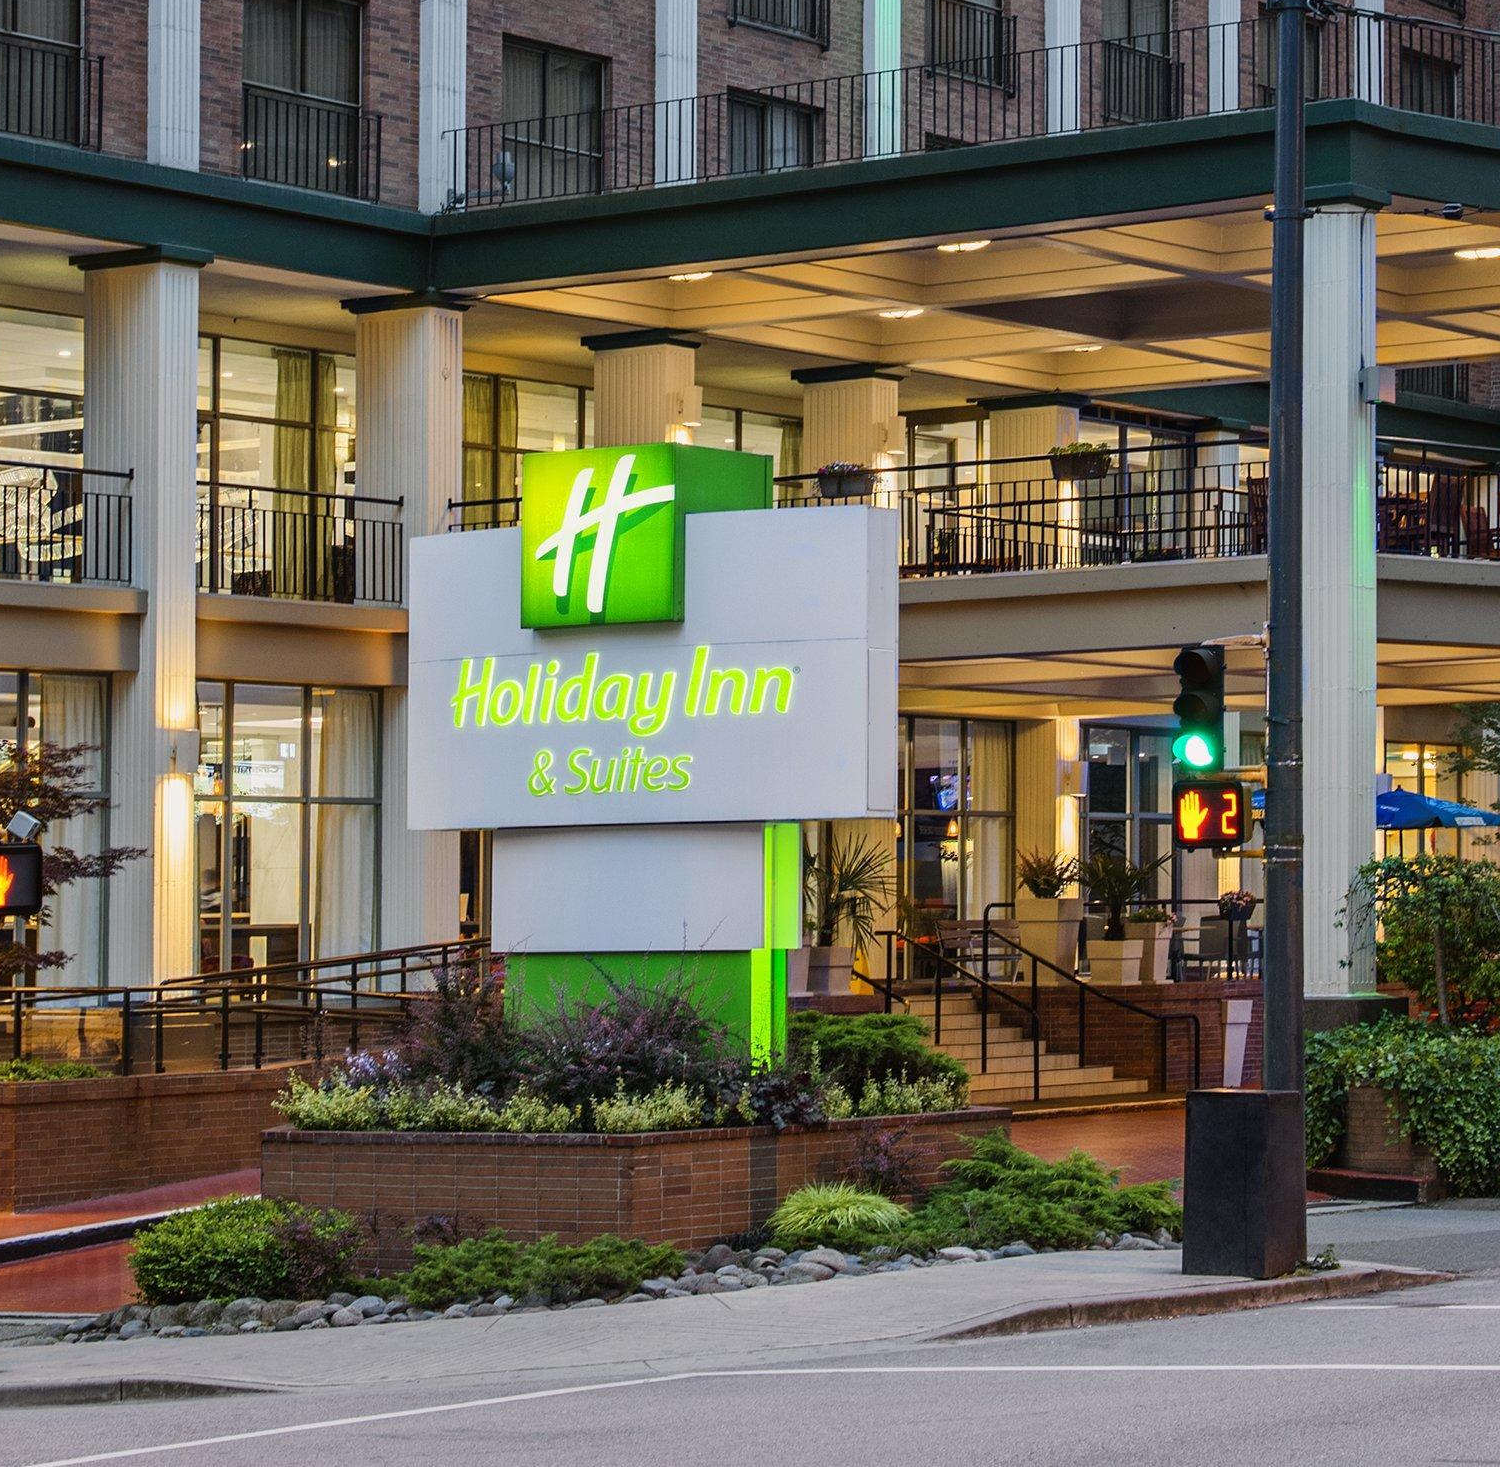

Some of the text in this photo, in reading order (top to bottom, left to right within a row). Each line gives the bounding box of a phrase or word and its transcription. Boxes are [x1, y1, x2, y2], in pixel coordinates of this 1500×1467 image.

[451, 645, 795, 738] Holiday Inn
[527, 746, 694, 798] & Suites
[1222, 793, 1237, 834] 2
